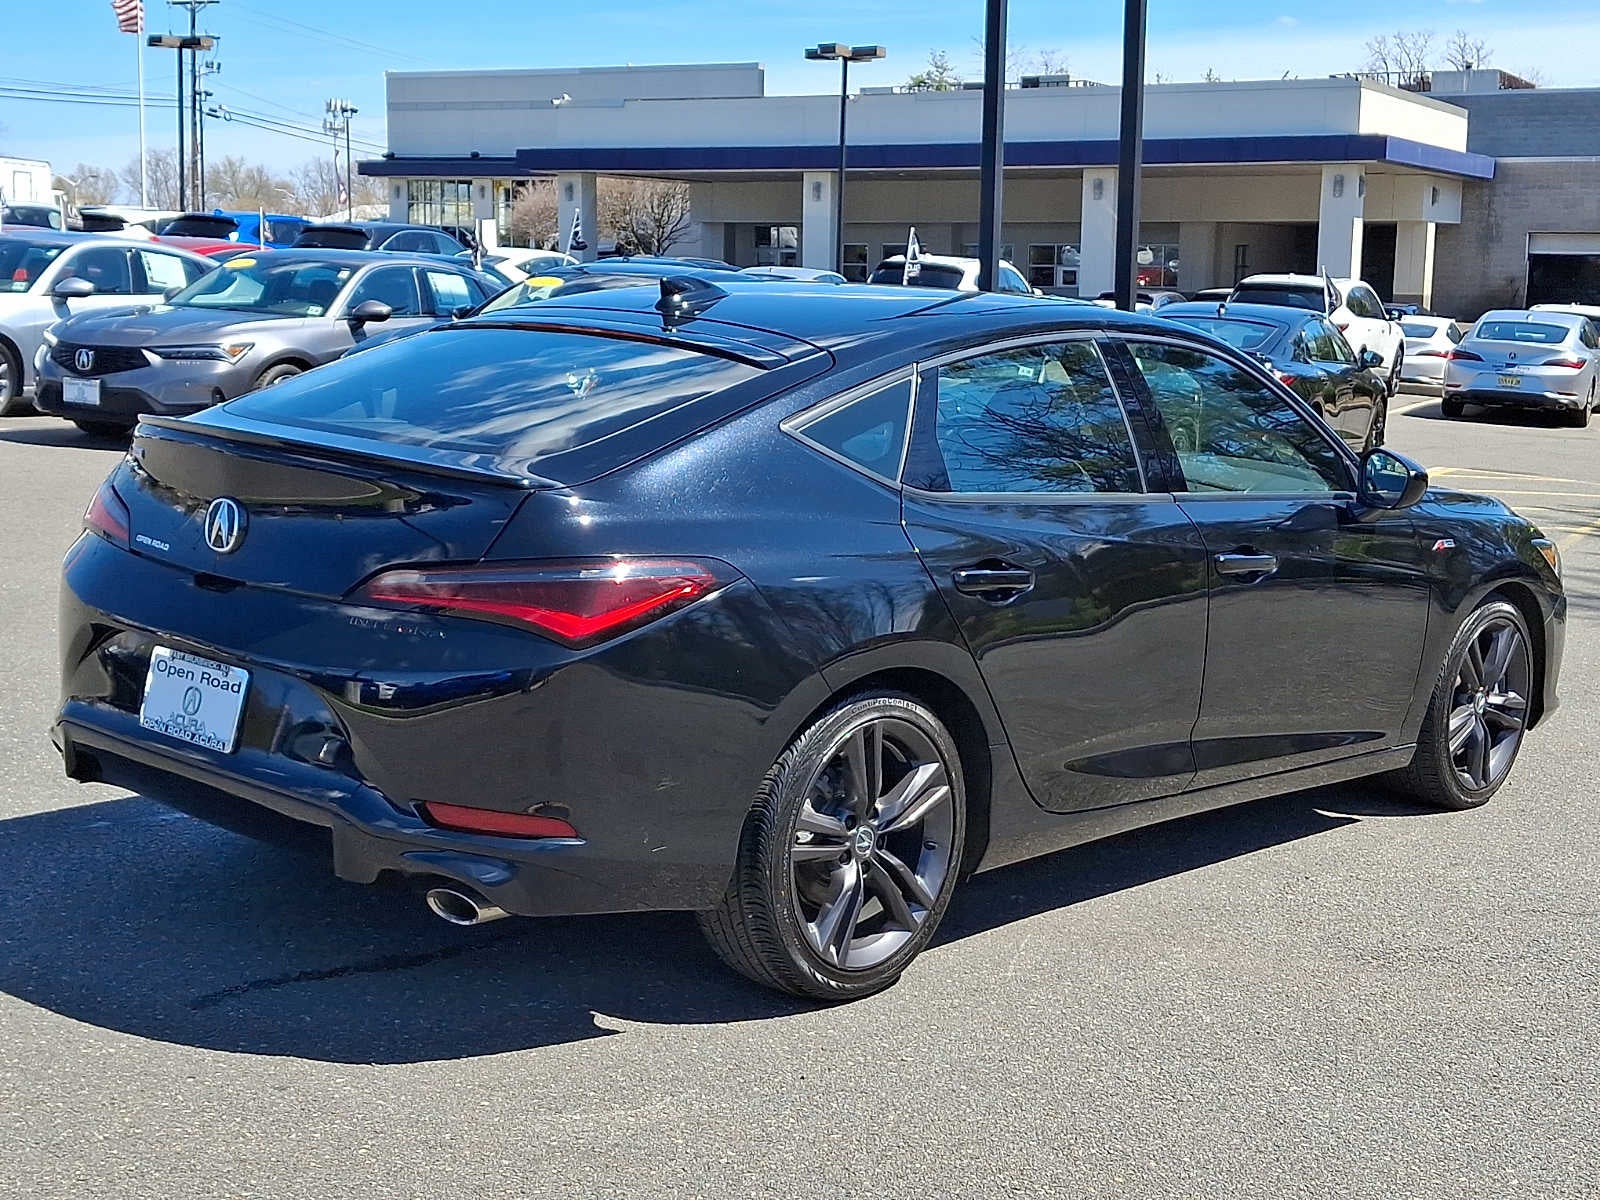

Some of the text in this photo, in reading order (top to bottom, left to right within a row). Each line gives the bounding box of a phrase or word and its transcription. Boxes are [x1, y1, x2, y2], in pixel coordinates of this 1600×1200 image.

[152, 539, 170, 551] ROAD
[157, 659, 195, 681] Open
[200, 672, 242, 694] Road
[144, 718, 224, 751] OPEN ROAD ACURA
